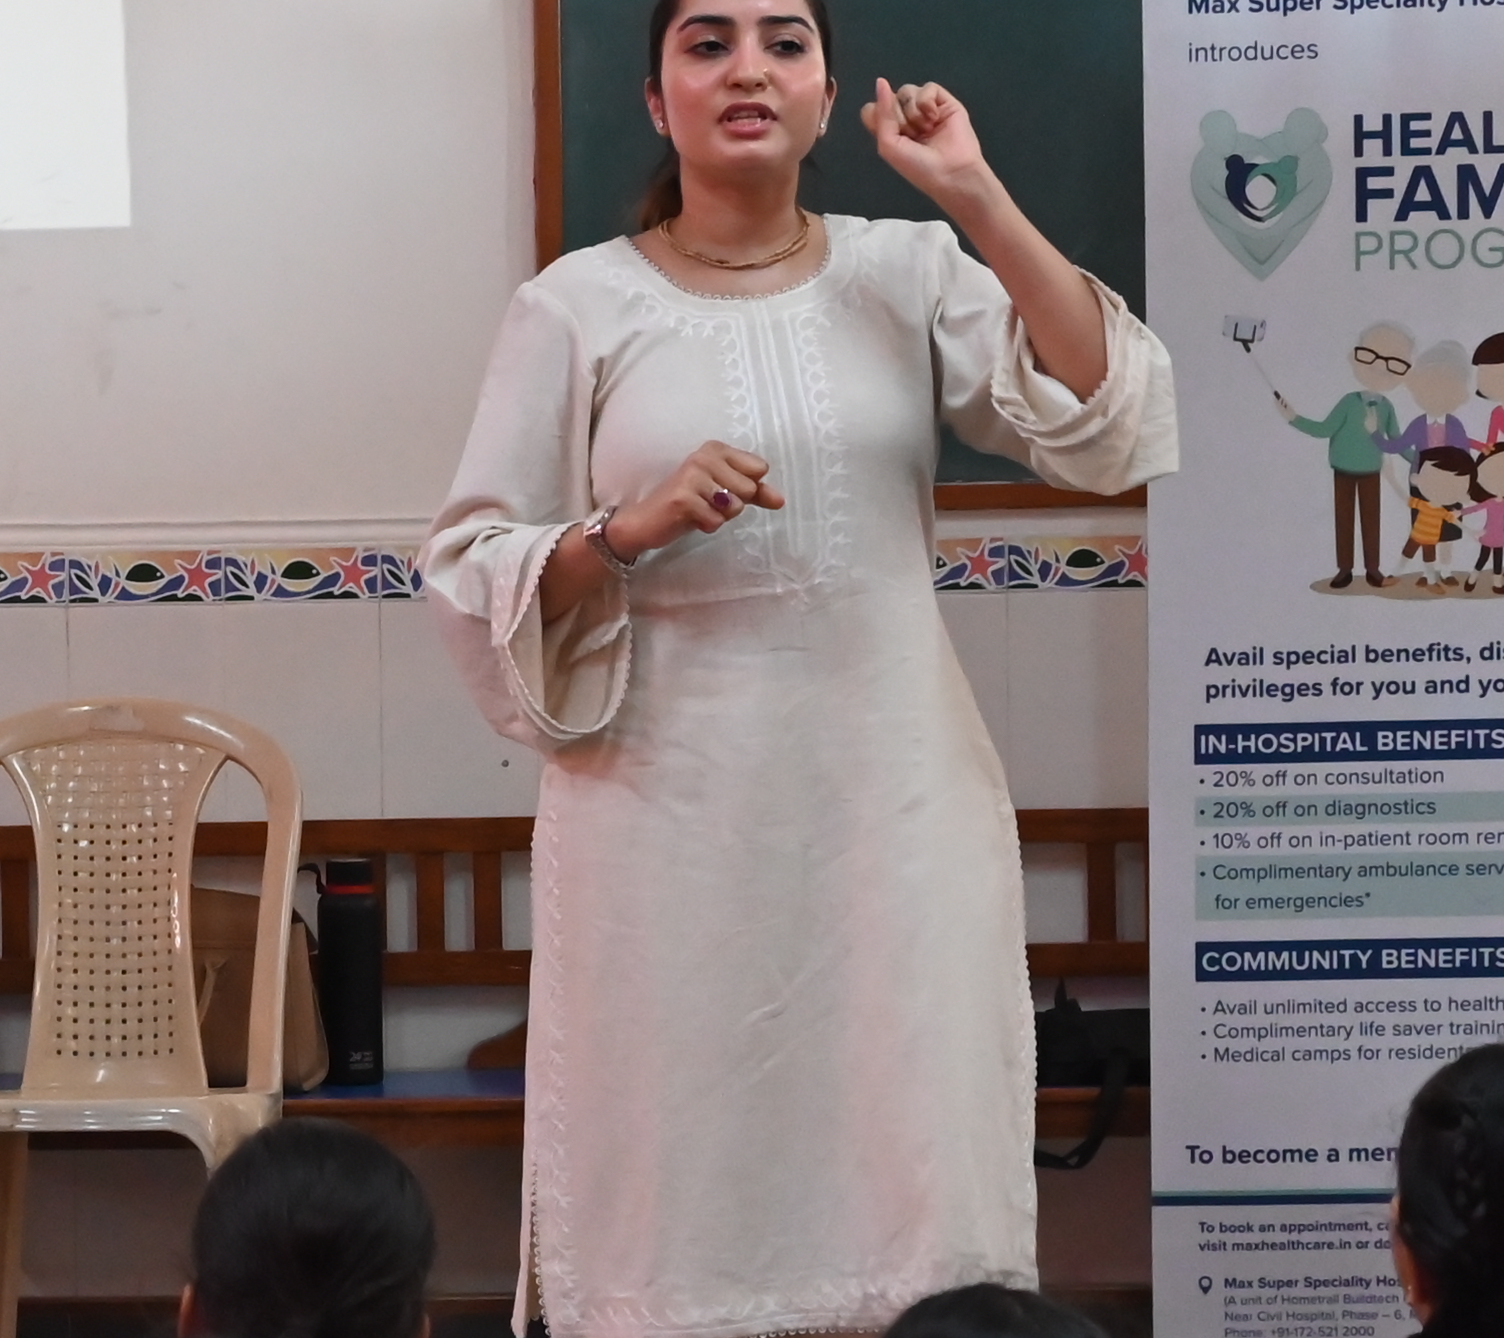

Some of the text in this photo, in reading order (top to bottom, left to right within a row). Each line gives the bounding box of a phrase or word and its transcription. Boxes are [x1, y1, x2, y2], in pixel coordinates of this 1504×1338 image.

[1187, 39, 1319, 63] introduces
[1204, 645, 1264, 667] Avail
[1272, 643, 1357, 671] special
[1364, 641, 1472, 664] benefits,
[1205, 678, 1324, 705] privileges
[1330, 676, 1365, 697] for
[1370, 679, 1416, 701] you
[1424, 674, 1471, 695] and
[1200, 731, 1369, 754] IN-HOSPITAL
[1212, 767, 1445, 788] 20% off on consultation
[1212, 798, 1437, 821] 20% off on diagnostics
[1212, 832, 1251, 850] 10%
[1256, 831, 1283, 850] off
[1288, 834, 1313, 849] on
[1319, 830, 1412, 851] in-patient
[1417, 831, 1470, 846] room
[1212, 863, 1353, 884] Complimentary
[1357, 860, 1460, 878] ambulance
[1201, 949, 1373, 972] COMMUNITY
[1212, 999, 1258, 1016] Avail
[1263, 997, 1348, 1016] unlimited
[1353, 999, 1418, 1014] access
[1422, 997, 1442, 1013] to
[1212, 1022, 1354, 1043] Complimentary
[1359, 1020, 1386, 1037] life
[1392, 1023, 1444, 1037] saver
[1213, 1044, 1472, 1065] Medical camps for resident
[1185, 1144, 1214, 1165] To
[1221, 1144, 1319, 1165] become
[1326, 1147, 1340, 1164] a
[1198, 1221, 1216, 1234] To
[1218, 1221, 1255, 1235] book
[1257, 1223, 1276, 1233] an
[1197, 1239, 1228, 1253] visit
[1354, 1240, 1370, 1250] or
[1223, 1276, 1254, 1290] Max
[1257, 1276, 1300, 1291] Super
[1303, 1275, 1373, 1291] Speciality
[1342, 1325, 1375, 1338] 2000
